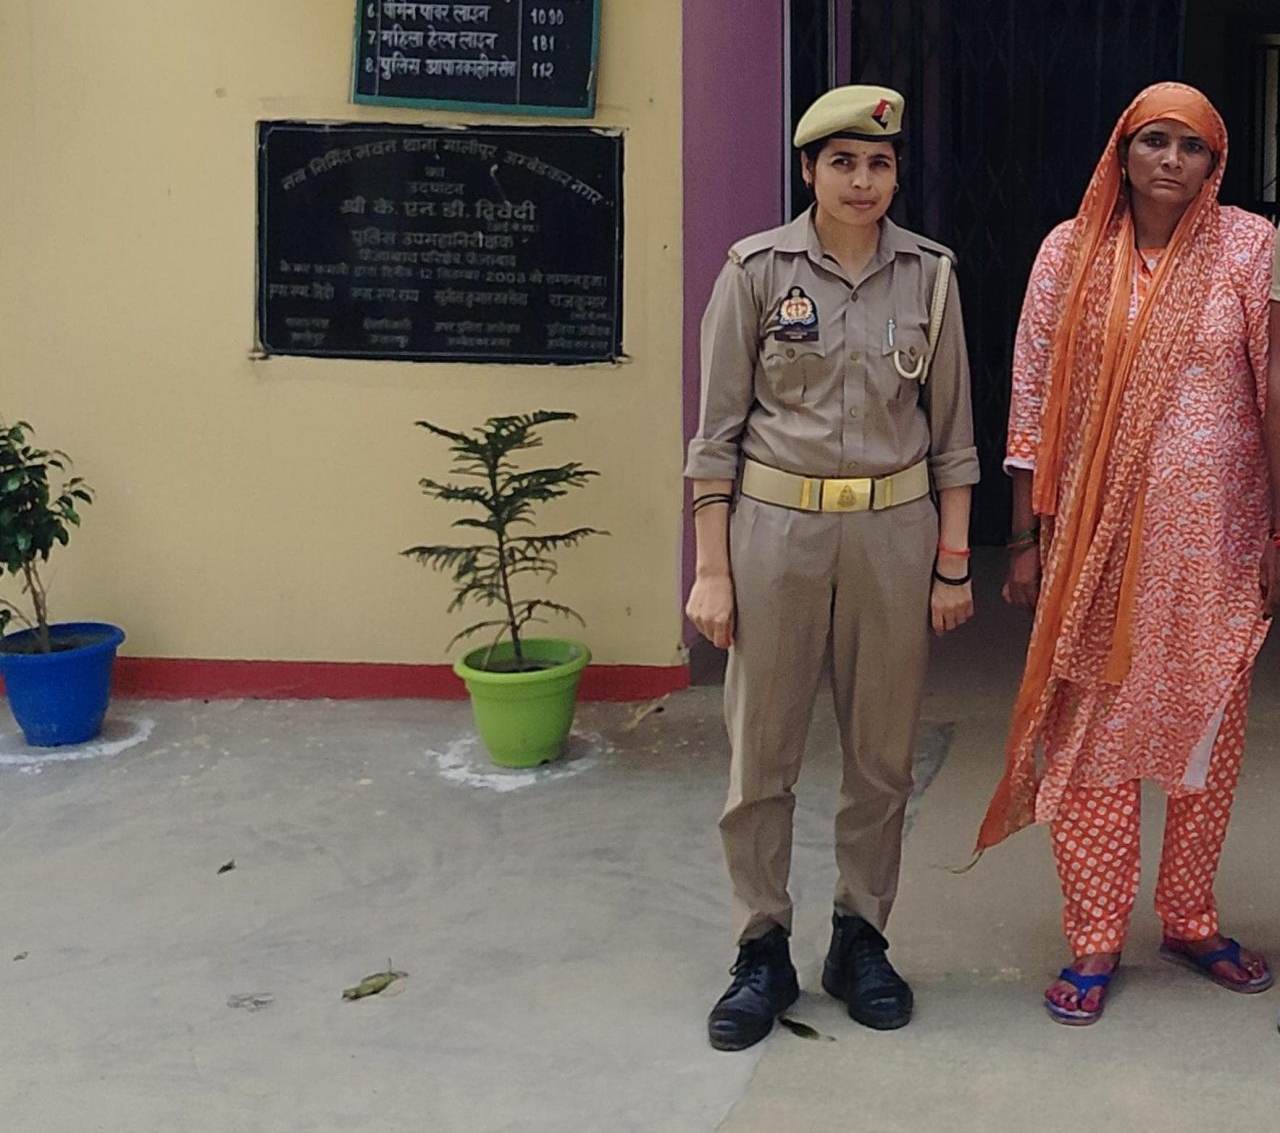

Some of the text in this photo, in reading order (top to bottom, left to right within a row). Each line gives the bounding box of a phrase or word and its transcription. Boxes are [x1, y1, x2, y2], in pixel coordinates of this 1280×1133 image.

[453, 5, 490, 24] लाइन
[530, 9, 564, 26] 1090
[381, 24, 423, 50] महिला
[459, 32, 498, 50] लाइन
[532, 36, 554, 51] 181
[380, 51, 421, 80] पुलिस
[532, 62, 553, 78] 112
[403, 137, 437, 153] थाना
[443, 137, 499, 159] मालीपुर
